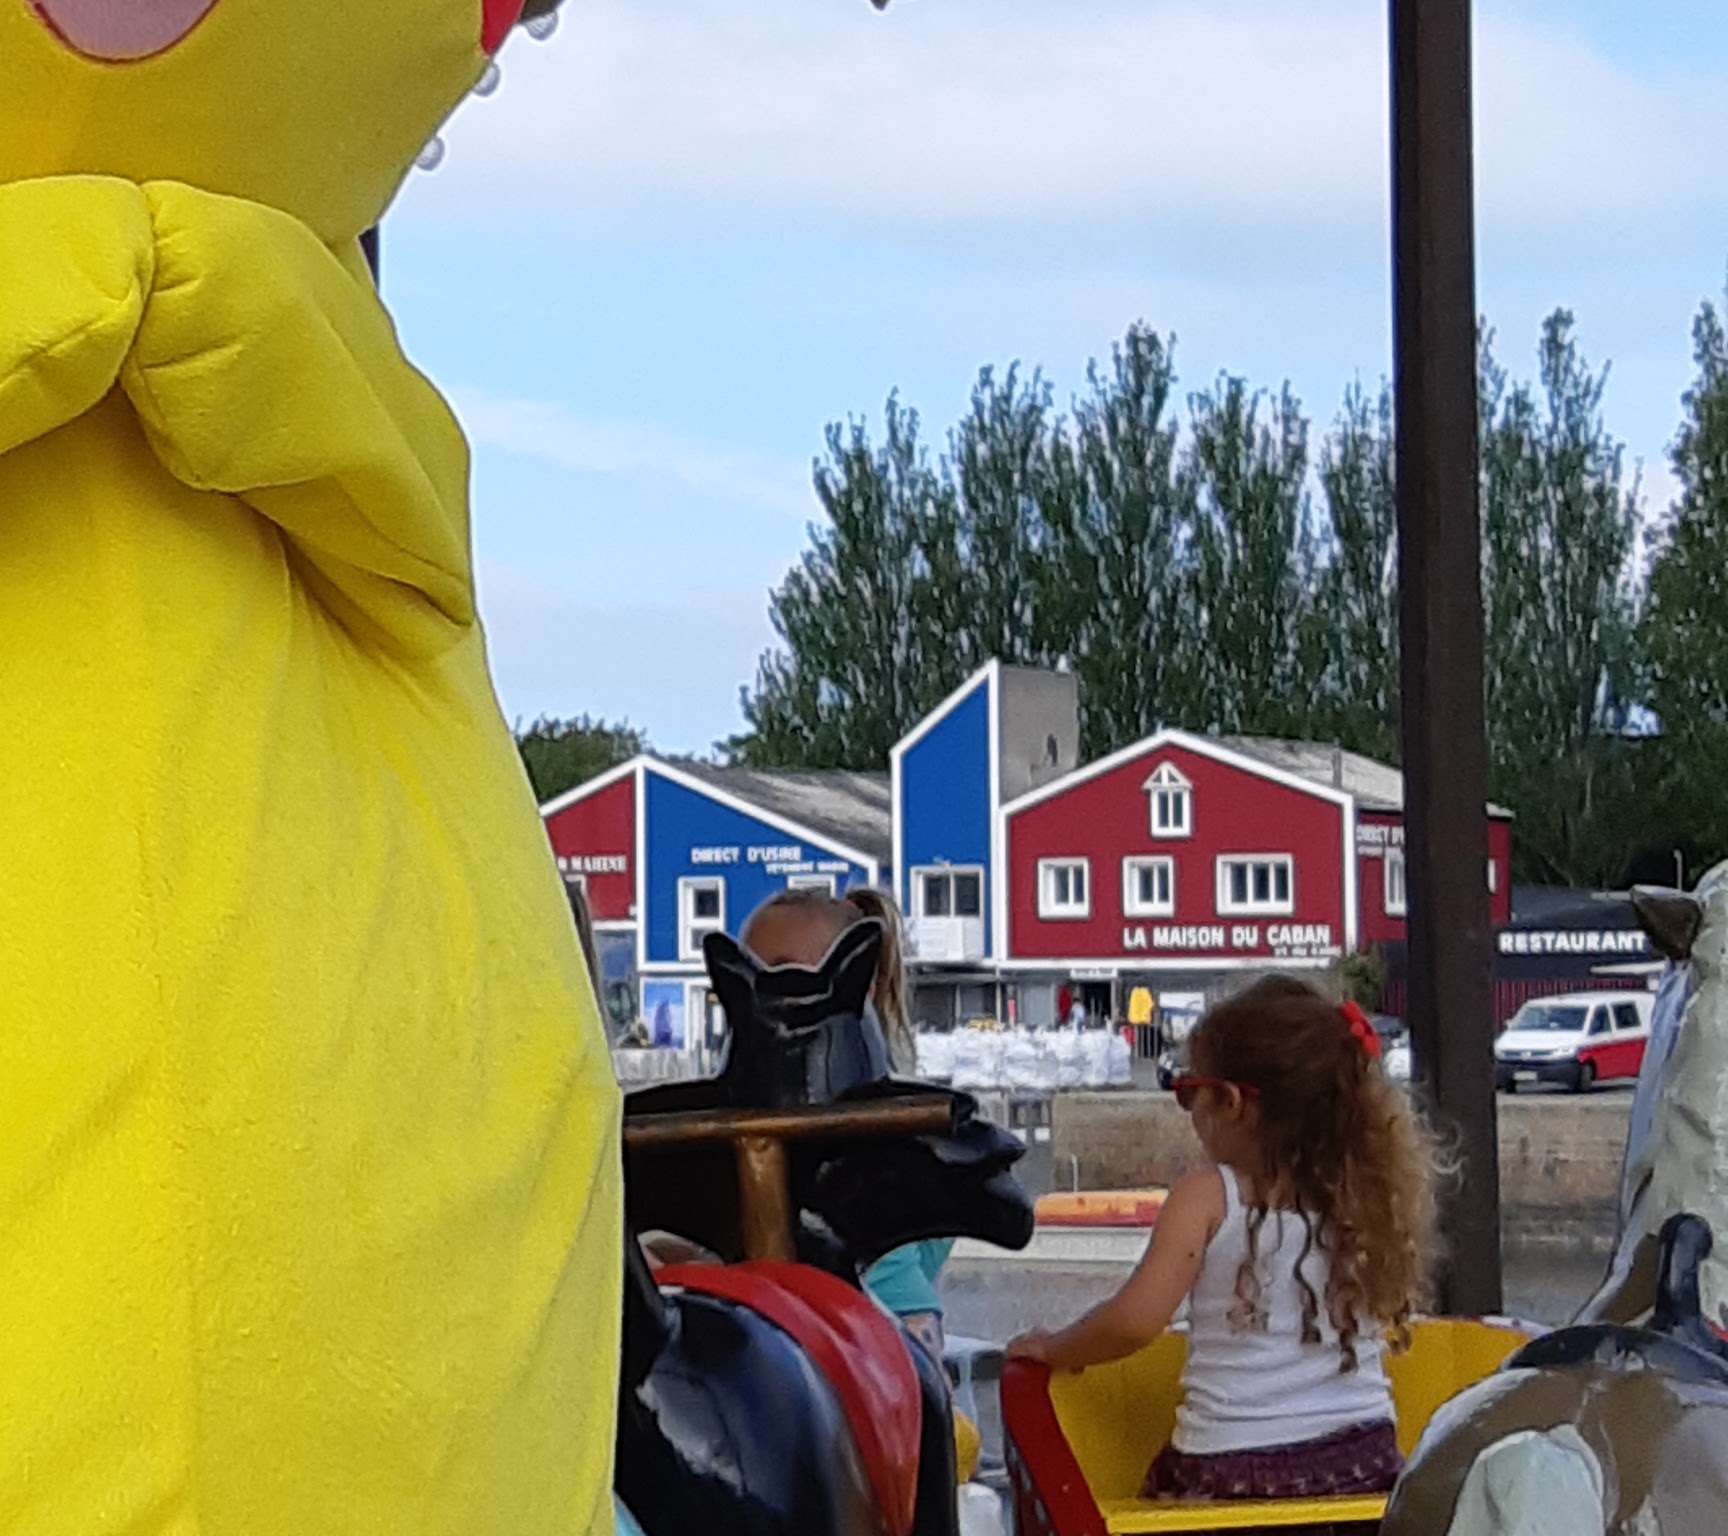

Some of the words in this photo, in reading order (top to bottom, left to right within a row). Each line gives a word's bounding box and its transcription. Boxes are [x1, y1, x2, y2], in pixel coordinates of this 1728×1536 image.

[691, 846, 739, 864] DIRECT
[1123, 927, 1146, 949] LA
[1152, 926, 1224, 948] MAISON
[1232, 925, 1258, 948] DU
[1267, 923, 1330, 947] CABAN
[1499, 931, 1645, 953] RESTAURANT
